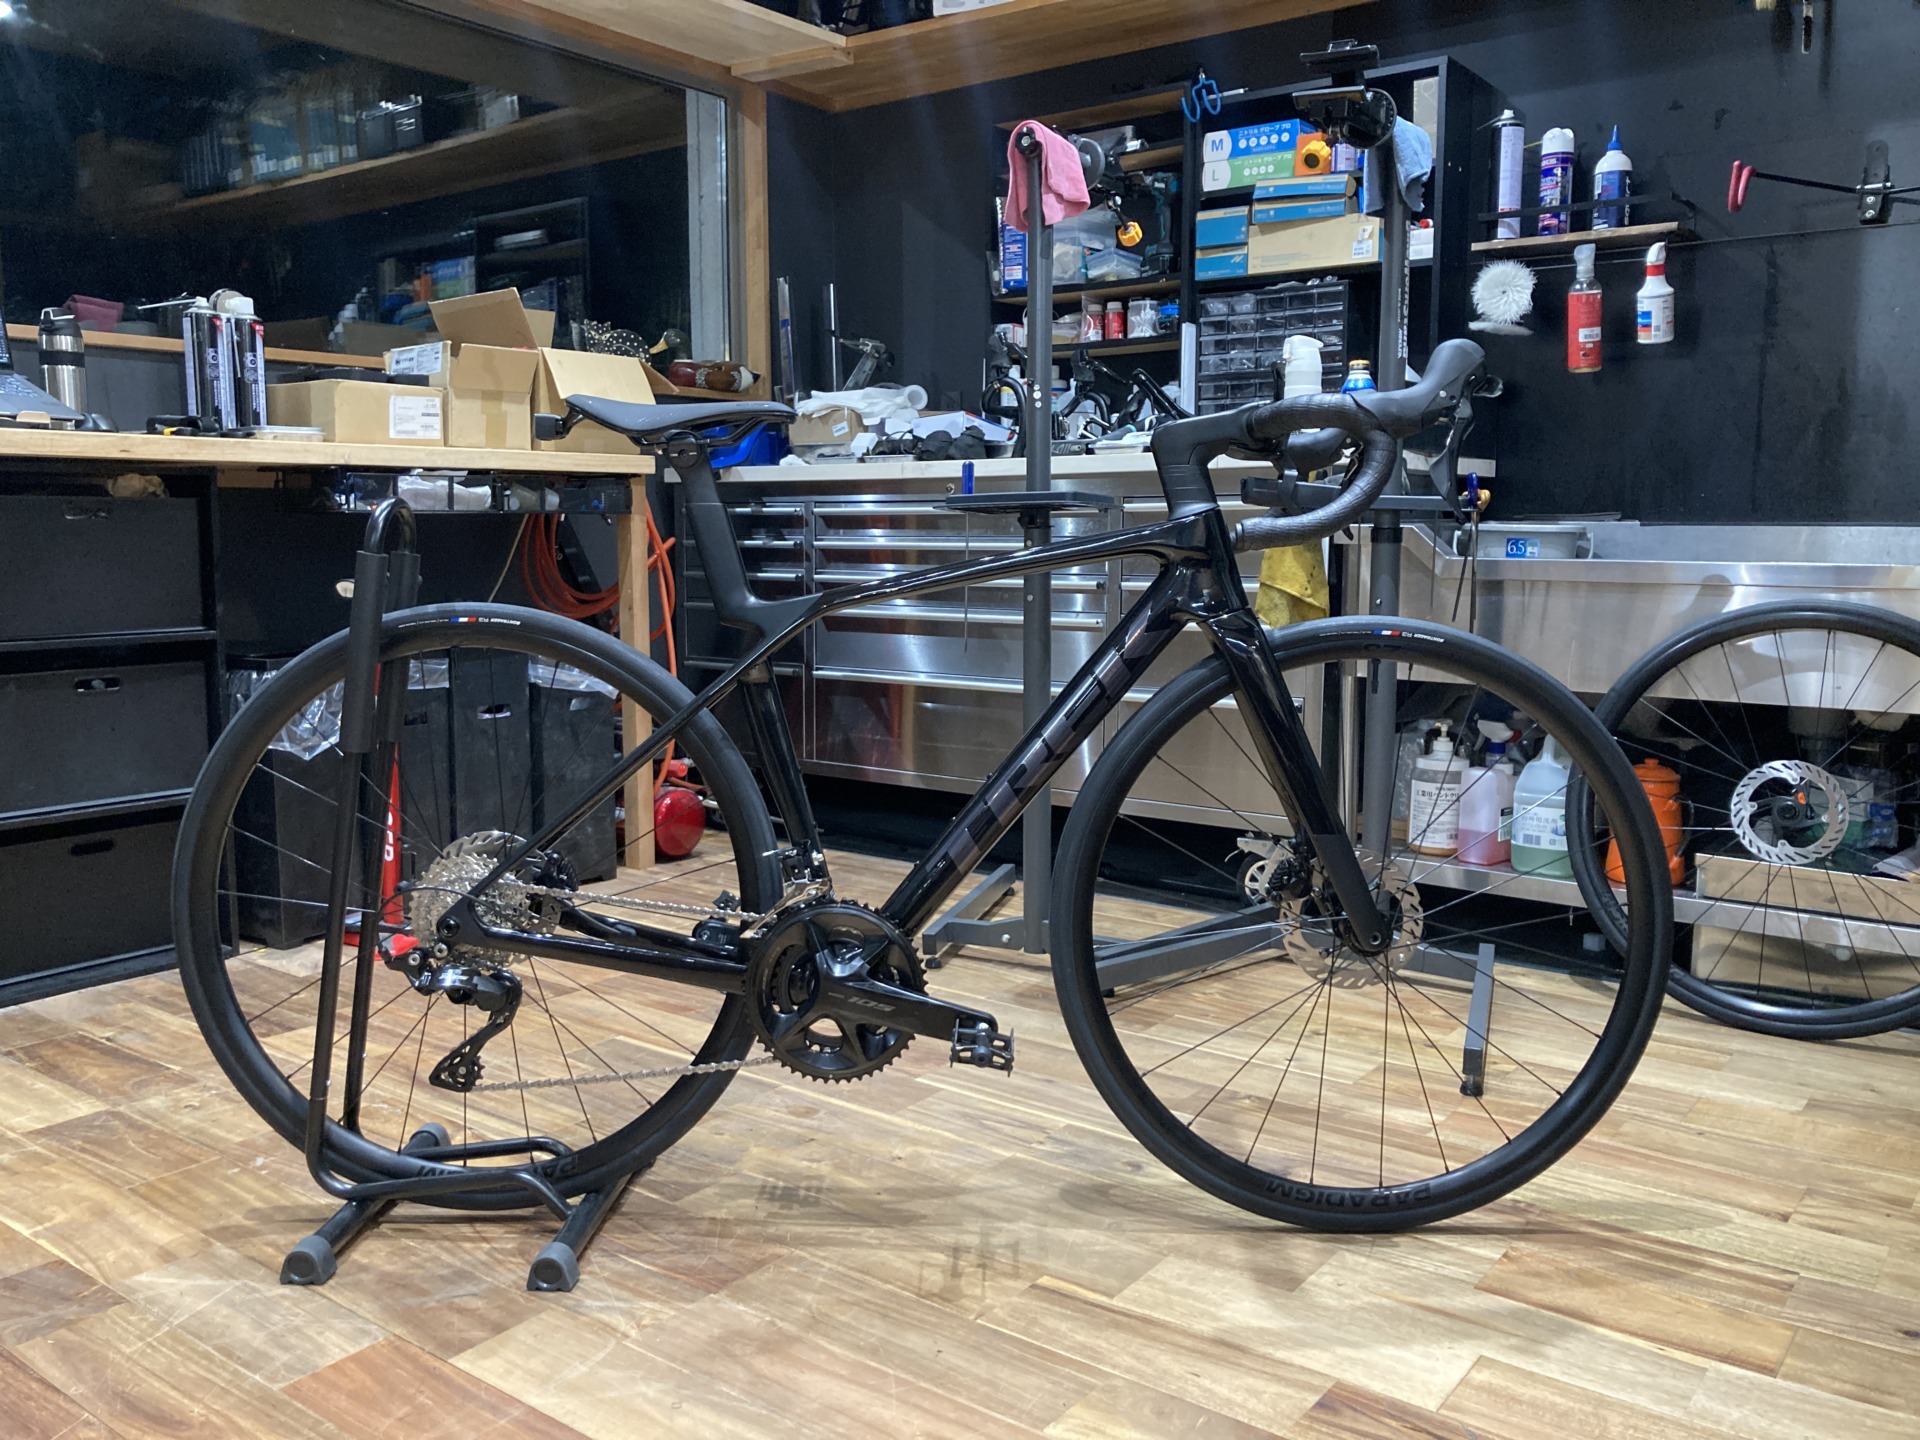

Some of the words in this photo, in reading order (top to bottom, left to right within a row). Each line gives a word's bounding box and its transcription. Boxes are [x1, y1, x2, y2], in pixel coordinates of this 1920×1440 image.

[1238, 128, 1259, 136] ニトリル
[1259, 124, 1280, 133] グローブ
[1280, 122, 1292, 130] プロ
[1211, 138, 1224, 152] M
[1212, 168, 1220, 182] L
[925, 601, 1170, 876] TREK
[848, 996, 896, 1011] 105
[1265, 1179, 1432, 1208] PARADIGM
